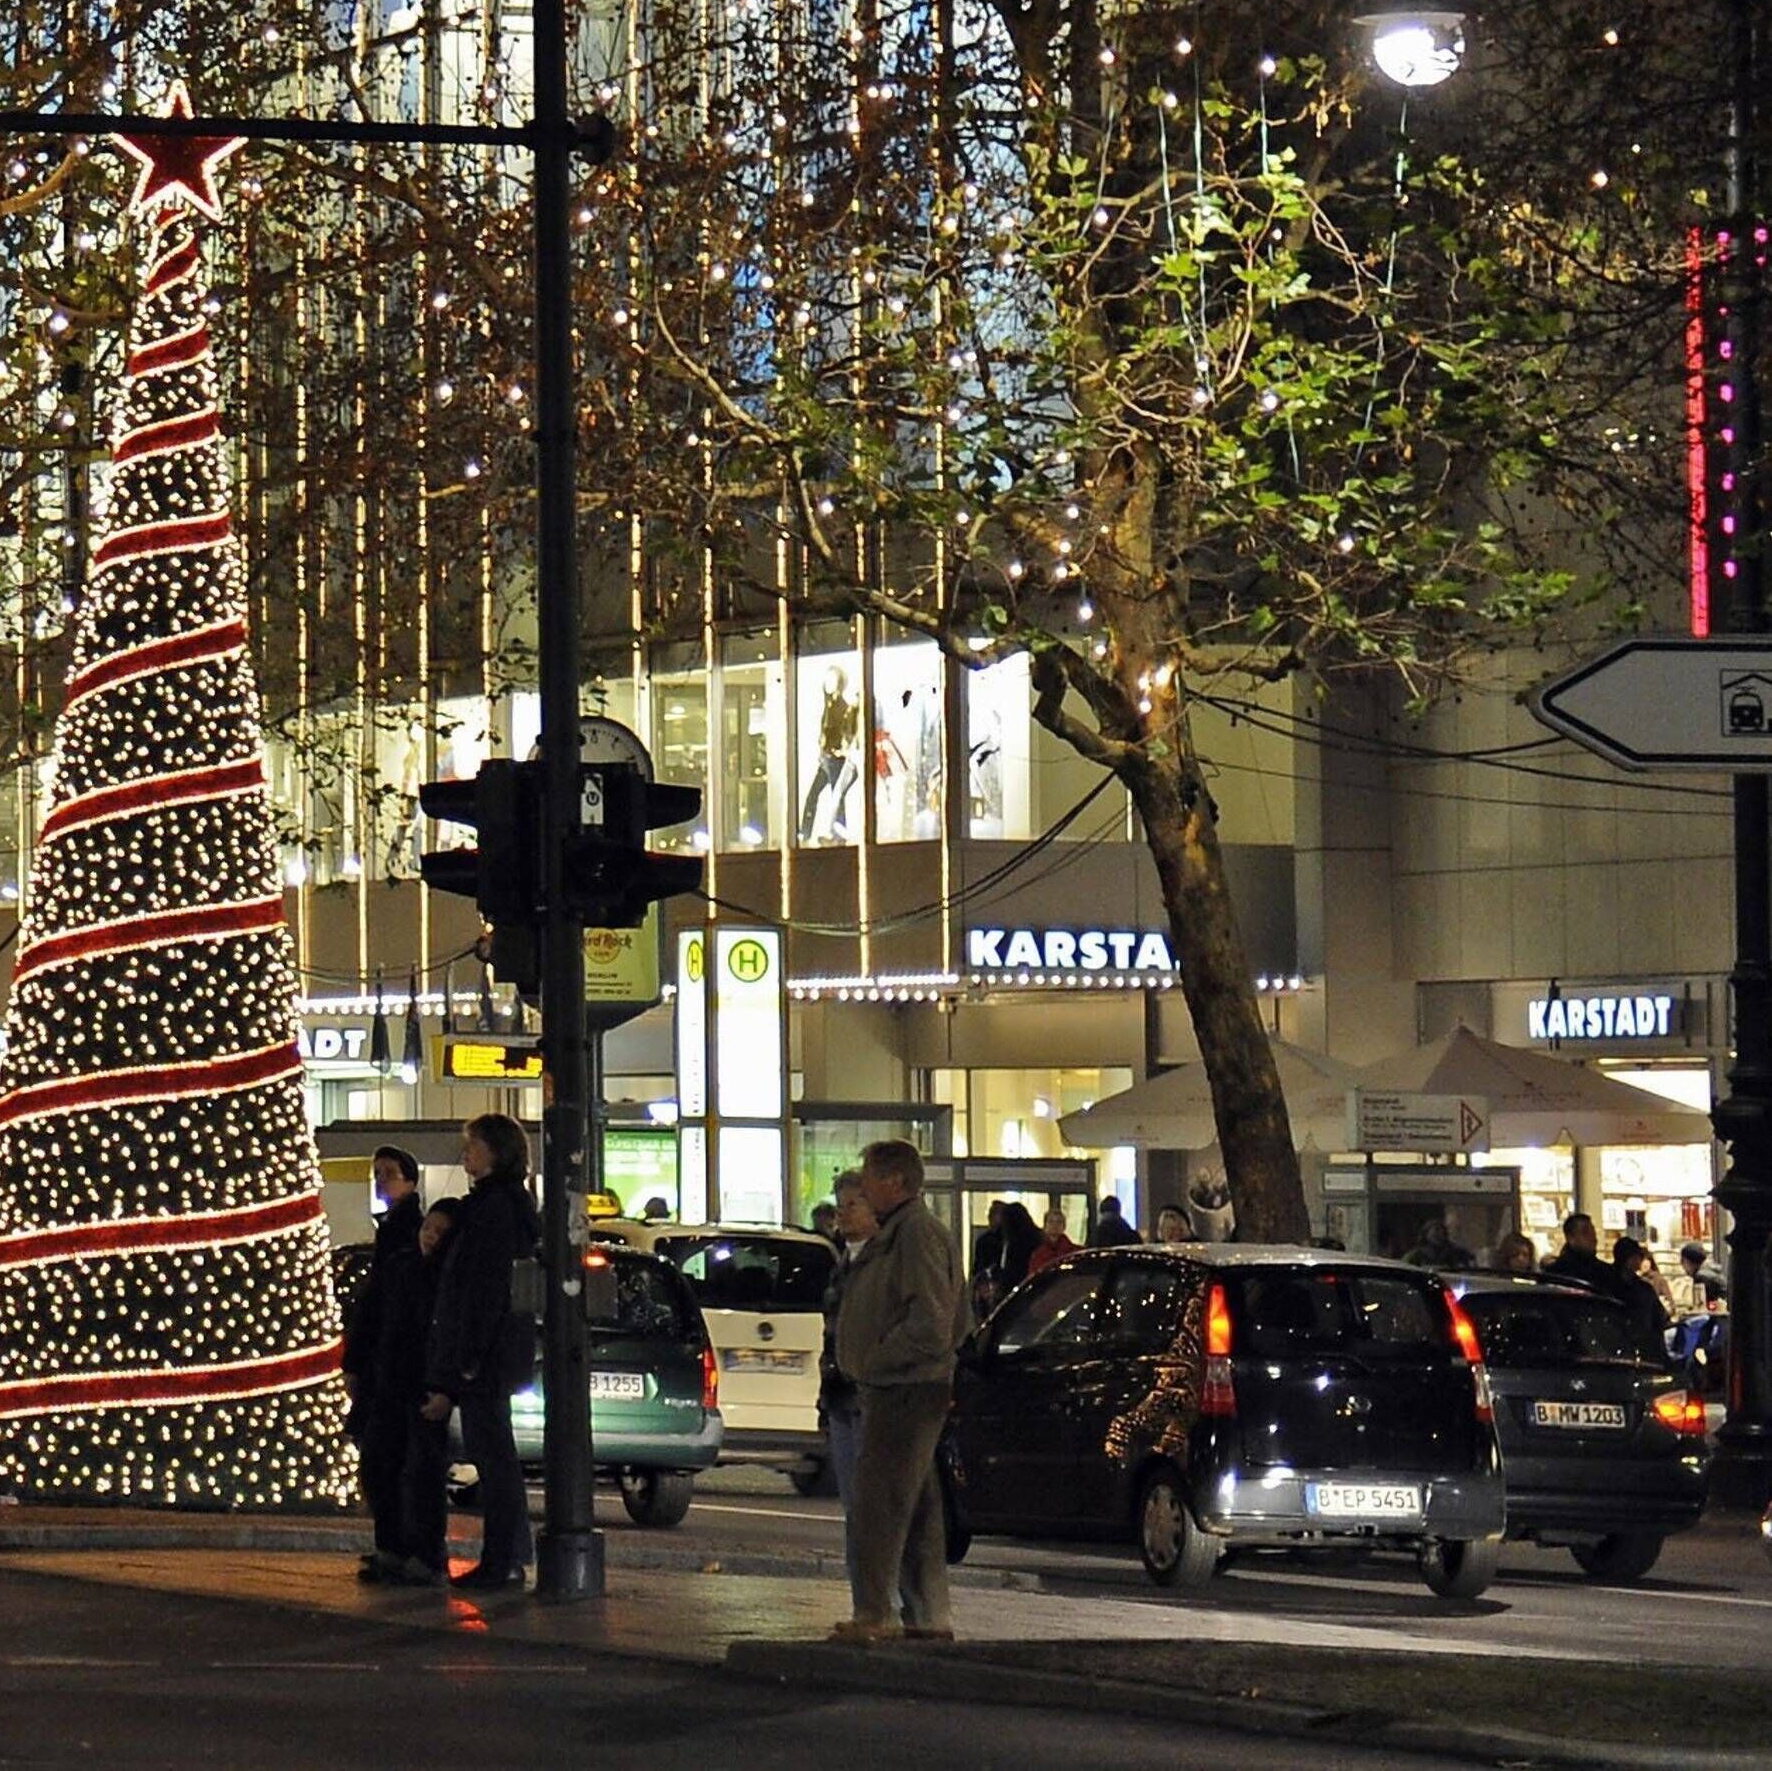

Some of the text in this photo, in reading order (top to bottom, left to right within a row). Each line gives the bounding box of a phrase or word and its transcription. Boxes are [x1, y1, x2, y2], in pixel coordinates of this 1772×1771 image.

[970, 929, 1181, 970] KARSTA
[1528, 996, 1671, 1039] KARSTADT
[603, 1376, 641, 1393] 1255
[1371, 1490, 1417, 1509] 5451
